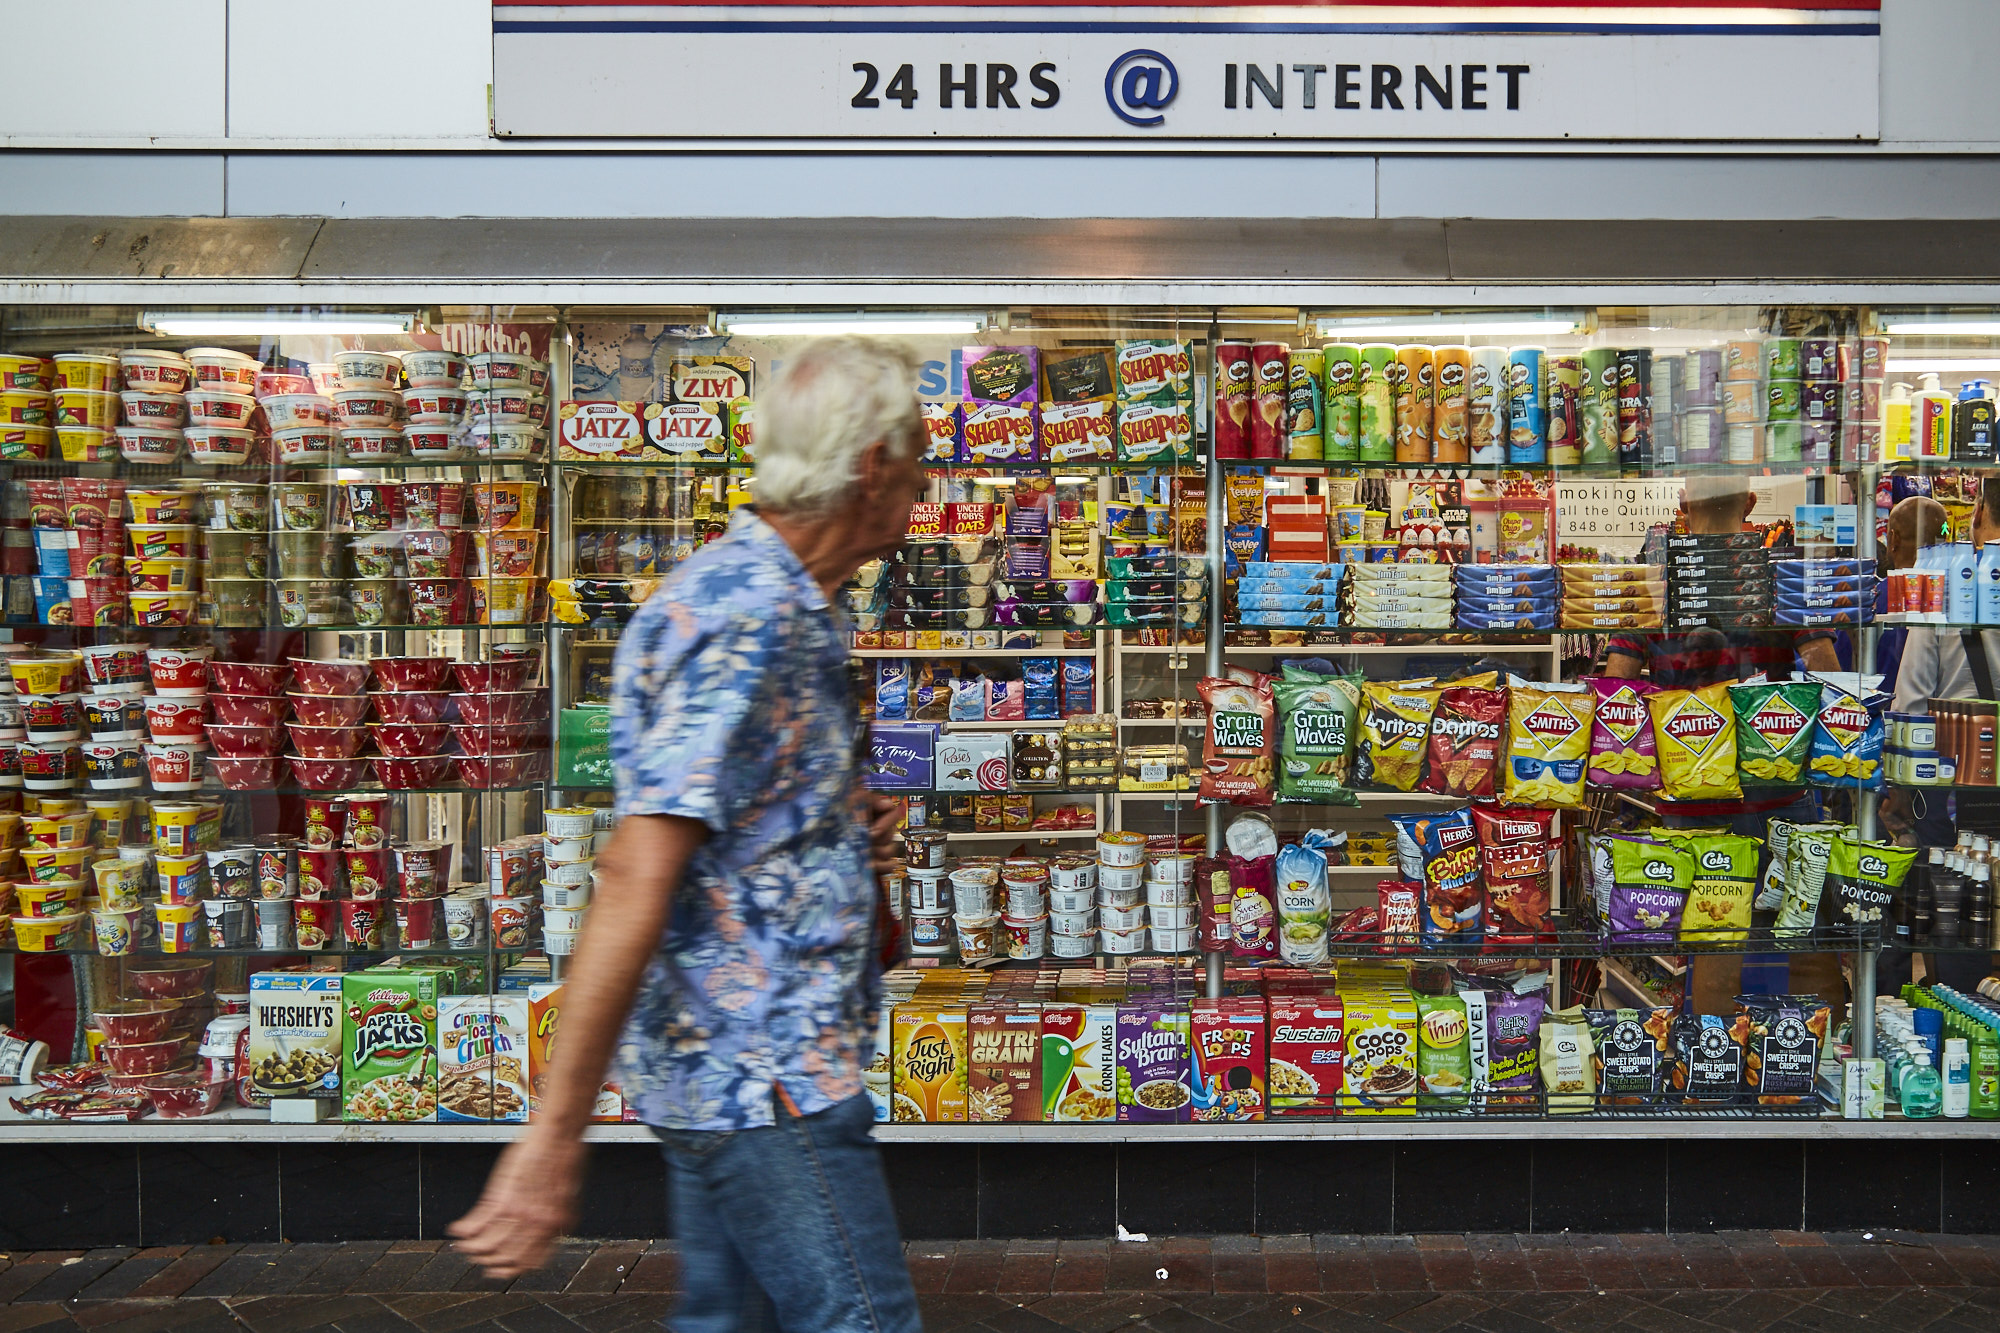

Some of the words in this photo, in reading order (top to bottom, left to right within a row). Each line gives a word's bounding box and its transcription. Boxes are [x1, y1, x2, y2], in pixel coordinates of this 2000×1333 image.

[851, 62, 917, 111] 24
[940, 62, 1061, 111] HRS
[1104, 48, 1180, 127] @
[1223, 62, 1531, 111] INTERNET
[683, 378, 737, 398] JATZ
[571, 418, 630, 440] JATZ
[657, 418, 713, 440] JATZ
[1560, 486, 1636, 503] moking
[957, 504, 984, 512] UNCLE
[1402, 508, 1437, 520] SURPRISE
[1560, 505, 1577, 516] all
[1585, 505, 1609, 516] the
[1618, 505, 1678, 516] Quitline
[957, 513, 984, 521] TOBYS
[909, 522, 940, 534] OATS
[955, 520, 985, 533] OATS
[1605, 523, 1620, 532] or
[147, 611, 163, 624] BEEF
[1315, 635, 1340, 643] MONTE
[882, 668, 900, 677] CSR
[1293, 710, 1346, 730] Grain
[1600, 702, 1646, 721] SMITH'S
[1823, 708, 1872, 727] SMITH'S
[1212, 712, 1264, 732] Grain
[1432, 717, 1499, 738] Doritos
[1528, 715, 1575, 732] SMITH'S
[1671, 714, 1721, 734] SMITH'S
[1754, 712, 1803, 730] SMITH'S
[1213, 728, 1265, 748] Waves
[1294, 726, 1346, 746] Waves
[167, 751, 188, 760] BIG
[940, 747, 971, 765] Roses
[1442, 827, 1473, 843] HERR'S
[1504, 824, 1537, 835] HERR'S
[1493, 858, 1548, 876] PIZZA
[1702, 852, 1731, 870] Cobs
[1859, 856, 1889, 878] Cobs
[1644, 861, 1674, 881] Cobs
[1440, 877, 1464, 891] Blue
[1284, 897, 1315, 907] CORN
[1631, 892, 1682, 907] POPCORN
[1841, 885, 1892, 904] POPCORN
[1387, 906, 1417, 915] Sticks
[352, 910, 375, 940] 辛
[368, 989, 410, 1003] Kellogg's
[260, 1006, 333, 1028] HERSHEY'S
[367, 1014, 410, 1028] APPLE
[453, 1013, 510, 1029] Cinnamon
[896, 1015, 923, 1025] Kellogg's
[1045, 1015, 1073, 1025] Kellogg's
[1120, 1015, 1147, 1025] Kellogg's
[467, 1024, 499, 1041] Toast
[1202, 1028, 1255, 1045] FROOT
[1272, 1025, 1341, 1043] Sustain
[1422, 1018, 1465, 1041] Thins
[1471, 1003, 1485, 1068] ALIVE!
[355, 1024, 424, 1062] JACKS
[457, 1034, 513, 1063] Crunch
[906, 1035, 950, 1060] Just
[1102, 1025, 1113, 1061] FLAKES
[1119, 1031, 1186, 1060] Sultana
[971, 1047, 1035, 1064] GRAIN
[1135, 1047, 1179, 1068] Bran
[1445, 1053, 1460, 1062] Tangy
[1607, 1057, 1627, 1066] SWEET
[1628, 1056, 1651, 1065] POTATO
[1767, 1054, 1787, 1063] SWEET
[1789, 1054, 1811, 1063] POTATO
[905, 1053, 956, 1082] Right
[1555, 1069, 1583, 1077] popcorn
[1618, 1065, 1639, 1073] CRISPS
[1693, 1063, 1713, 1072] SWEET
[1714, 1063, 1736, 1072] POTATO
[1705, 1071, 1724, 1079] CRISPS
[1102, 1063, 1113, 1092] CORN
